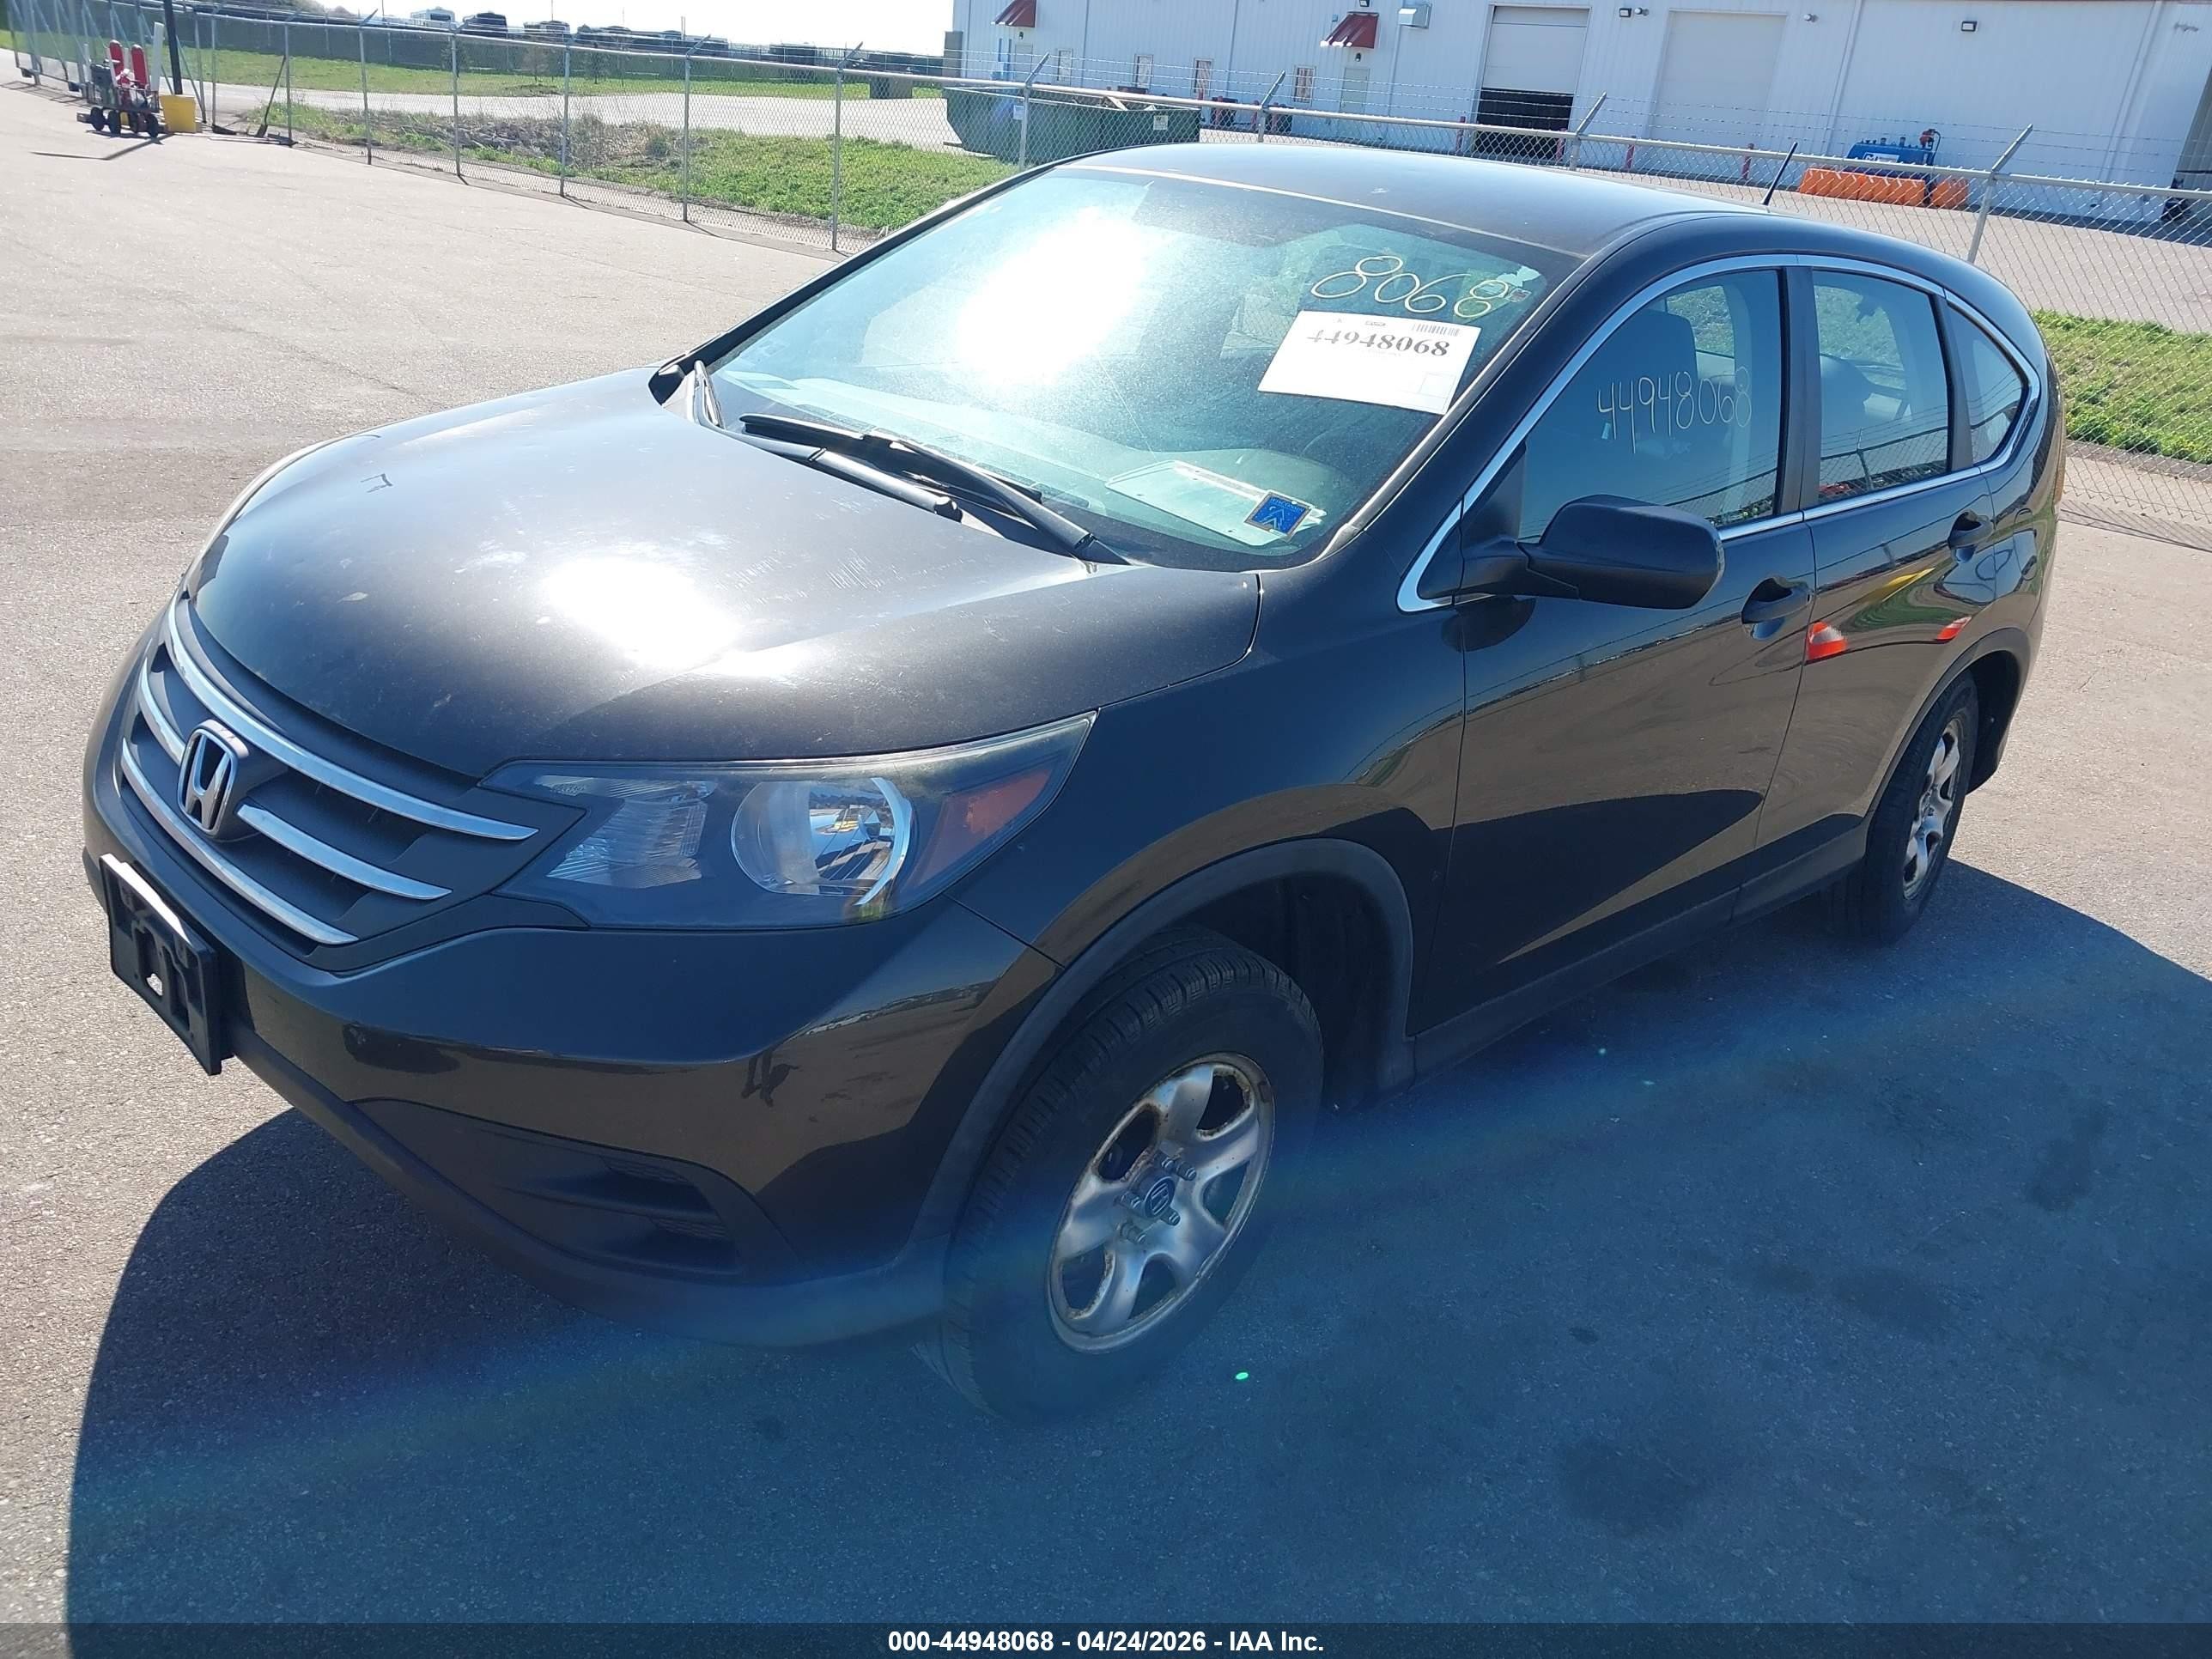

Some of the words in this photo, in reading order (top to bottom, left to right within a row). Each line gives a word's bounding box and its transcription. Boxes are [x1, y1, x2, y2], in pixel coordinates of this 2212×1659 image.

[1310, 255, 1510, 318] 8068
[1306, 329, 1451, 356] 44948068
[1597, 365, 1753, 454] 44948068
